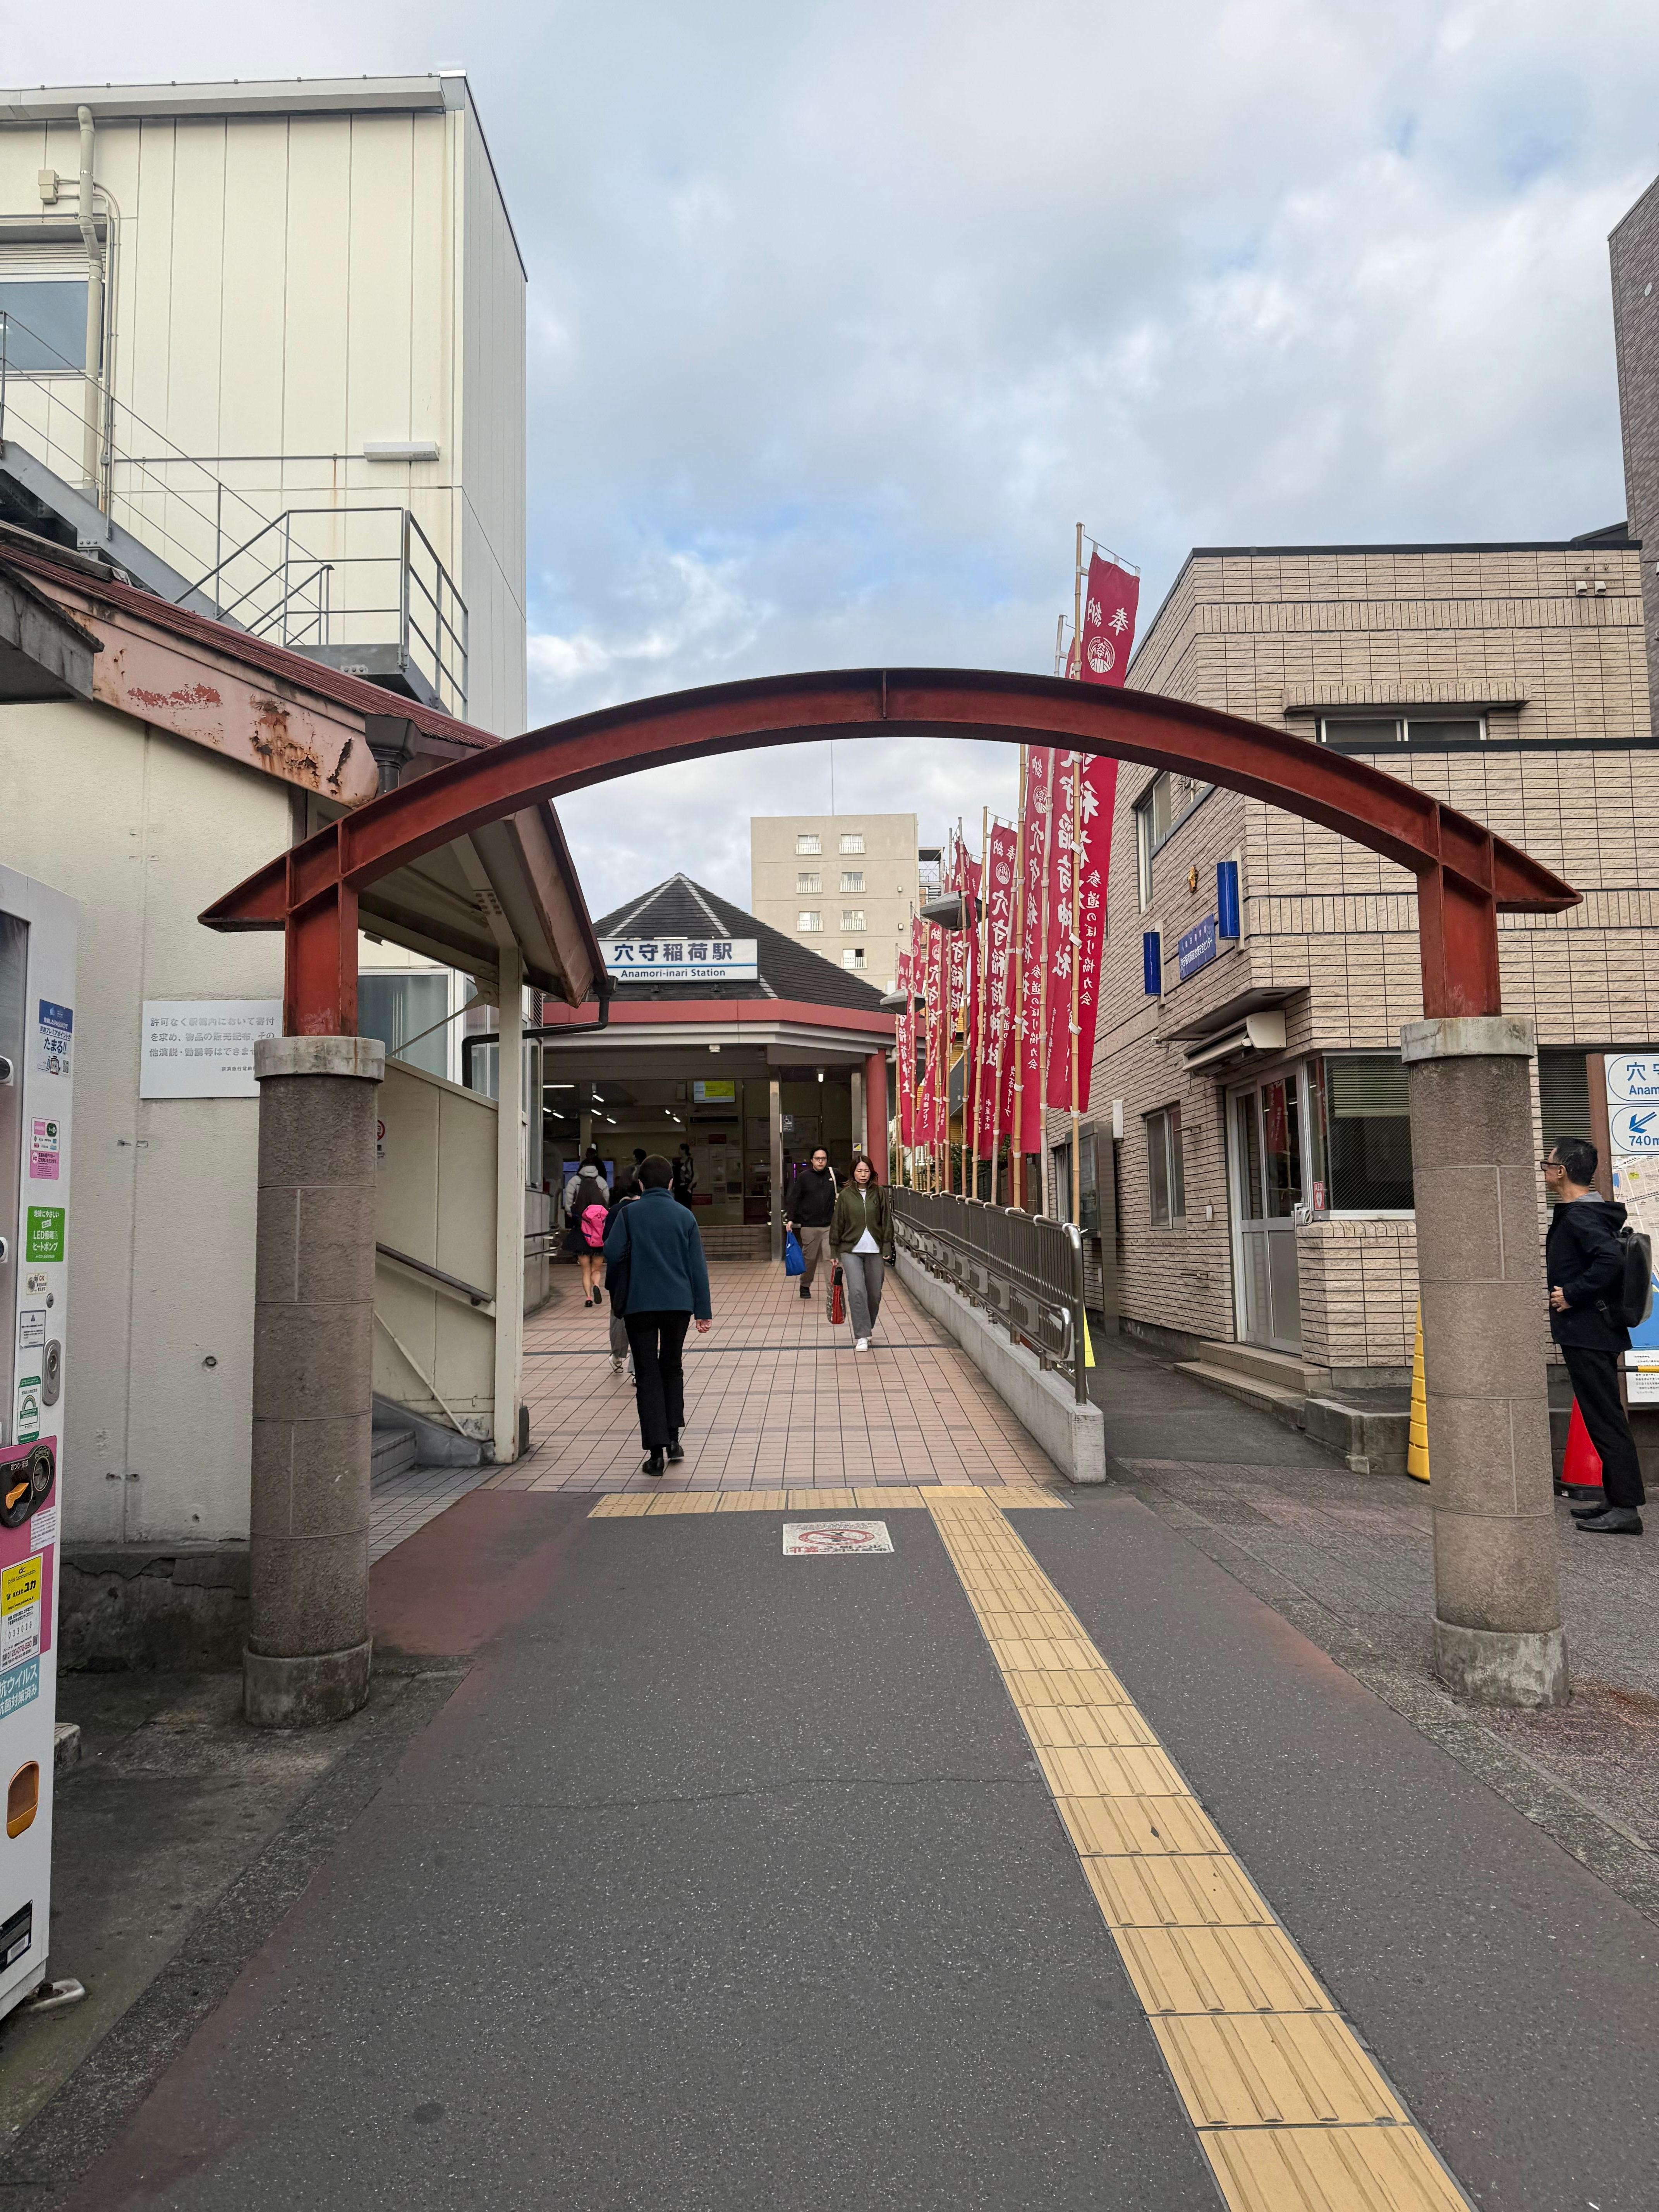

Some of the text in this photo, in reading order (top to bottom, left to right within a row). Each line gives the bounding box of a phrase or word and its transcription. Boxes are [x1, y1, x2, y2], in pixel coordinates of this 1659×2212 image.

[614, 943, 733, 962] 穴守稲荷駅
[621, 968, 725, 977] Anamori-inari Station
